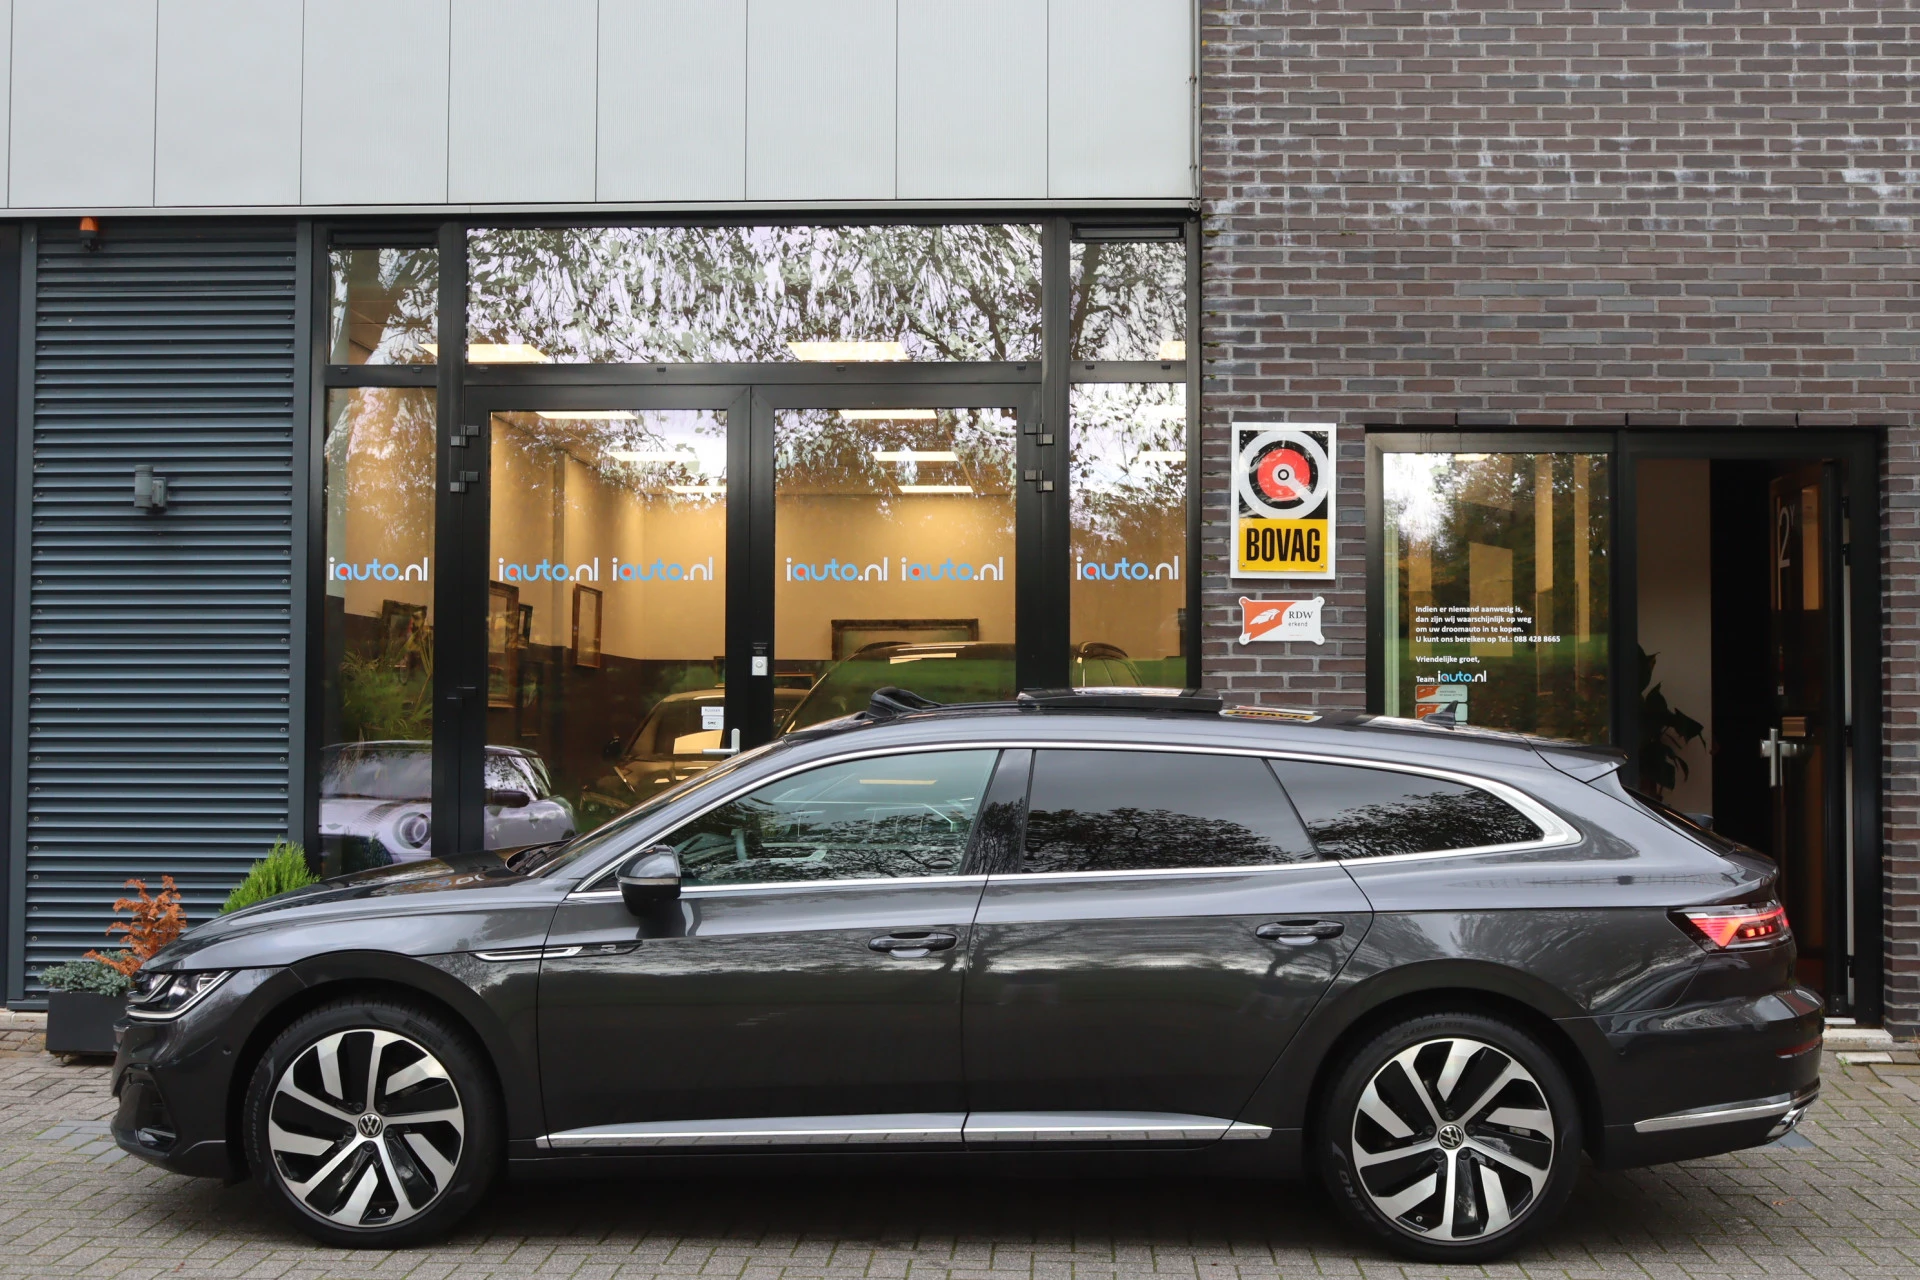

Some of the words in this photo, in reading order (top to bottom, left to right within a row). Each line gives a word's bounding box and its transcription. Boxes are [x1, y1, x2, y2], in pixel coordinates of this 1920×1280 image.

[1246, 527, 1321, 562] BOVAG
[329, 556, 429, 581] iauto.nl
[498, 556, 599, 581] iauto.nl
[612, 556, 713, 581] iauto.nl
[786, 557, 889, 581] iauto.nl
[901, 556, 1004, 581] iauto.nl
[1076, 555, 1179, 581] iauto.nl
[1288, 610, 1313, 619] RDW
[1415, 605, 1438, 613] Indien
[1448, 605, 1480, 613] niemand
[1481, 605, 1514, 614] aanwezig
[1515, 605, 1523, 614] is,
[1415, 615, 1430, 623] dan
[1430, 615, 1443, 624] zijn
[1444, 615, 1456, 624] wij
[1456, 615, 1505, 624] waarschijnlijk
[1506, 616, 1516, 624] op
[1517, 616, 1532, 624] weg
[1441, 625, 1481, 633] droomauto
[1482, 625, 1490, 633] in
[1499, 625, 1524, 634] kopen.
[1415, 635, 1422, 643] U
[1423, 635, 1440, 643] kunt
[1454, 635, 1486, 643] bereiken
[1486, 636, 1497, 644] op
[1513, 635, 1528, 643] 088
[1528, 635, 1542, 643] 428
[1543, 635, 1561, 643] 8665
[1415, 655, 1458, 664] Vriendelijke
[1458, 655, 1480, 664] groet,
[1415, 675, 1435, 683] Team
[1437, 670, 1487, 683] iauto.nl
